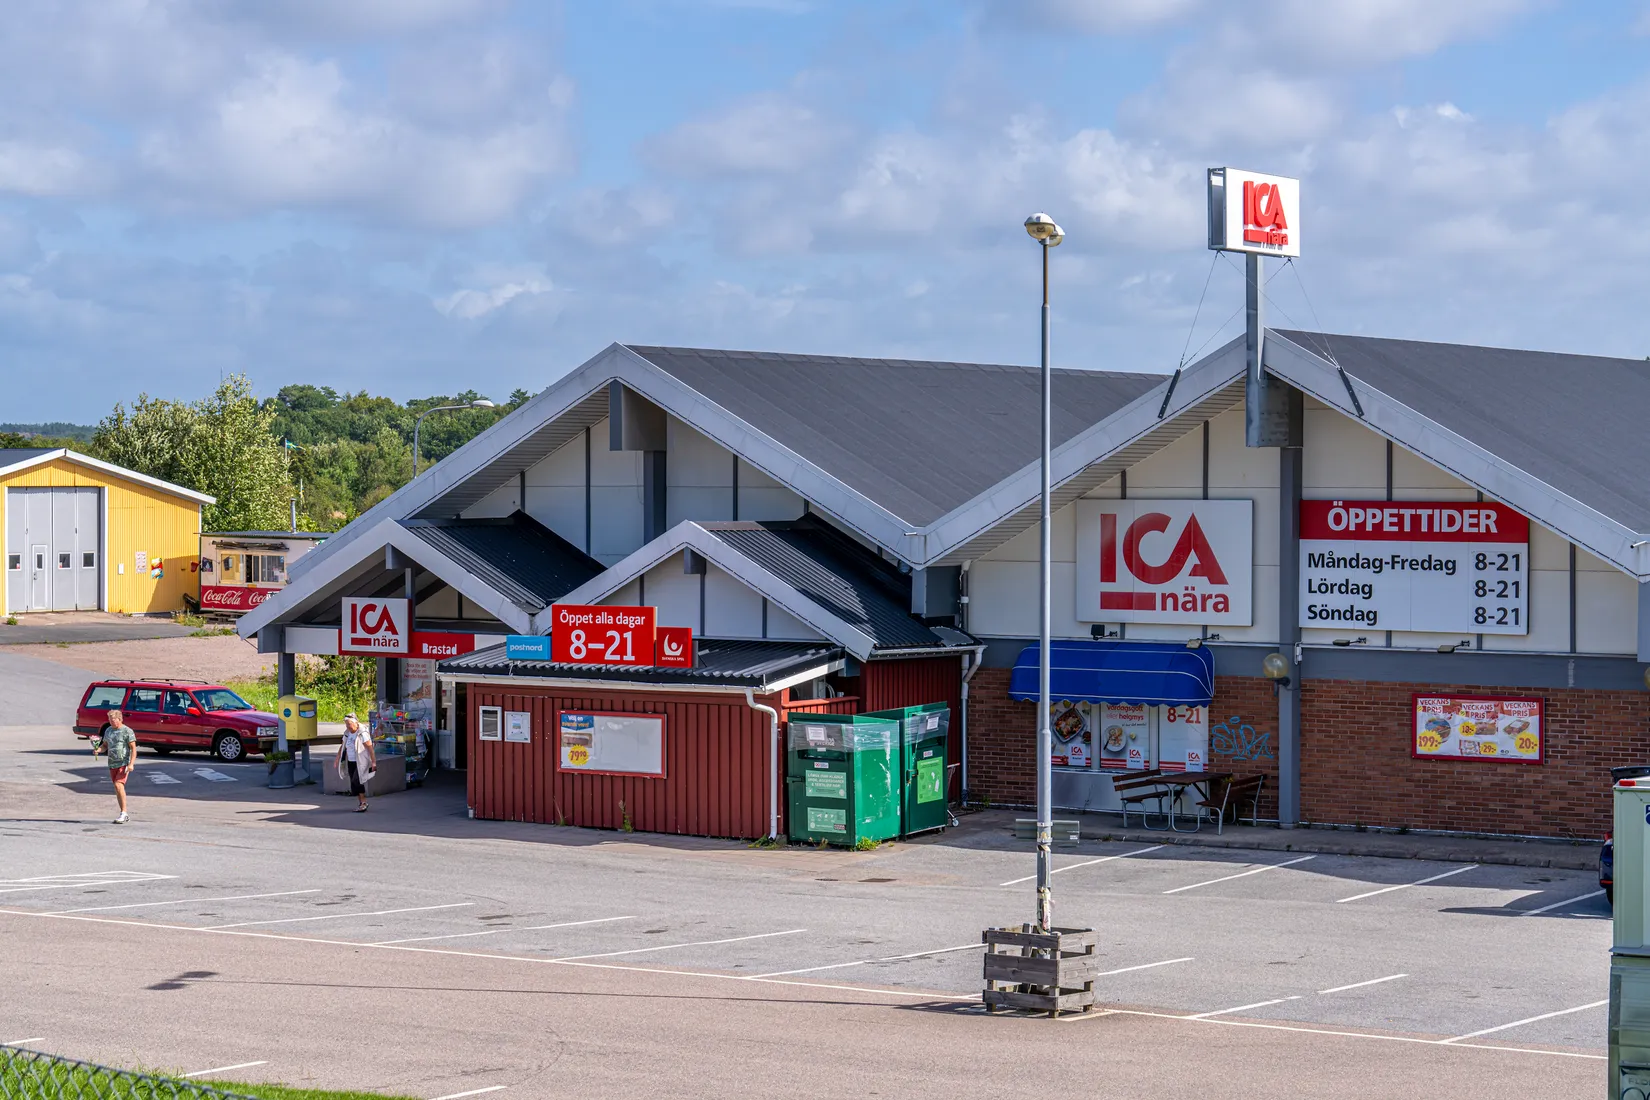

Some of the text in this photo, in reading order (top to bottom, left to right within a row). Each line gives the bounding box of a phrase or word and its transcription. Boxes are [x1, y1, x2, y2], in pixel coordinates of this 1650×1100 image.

[1243, 181, 1288, 230] ICA
[1267, 228, 1289, 245] nära
[1327, 501, 1499, 534] ÖPPETTIDER
[1100, 512, 1230, 585] ICA
[1307, 550, 1520, 576] Måndag-Fredag 8-21
[1307, 578, 1520, 600] Lördag 8-21
[1160, 586, 1230, 613] nära
[351, 603, 399, 635] ICA
[559, 610, 646, 628] Öppet alla dagar
[1307, 604, 1520, 626] Söndag 8-21
[373, 635, 399, 647] nära
[422, 643, 458, 655] Brastad
[569, 629, 636, 661] 8-21
[1470, 711, 1486, 719] PRIS
[1071, 746, 1083, 754] ICA
[1129, 749, 1142, 757] ICA
[1518, 738, 1538, 750] 20:-
[1187, 752, 1201, 760] ICA
